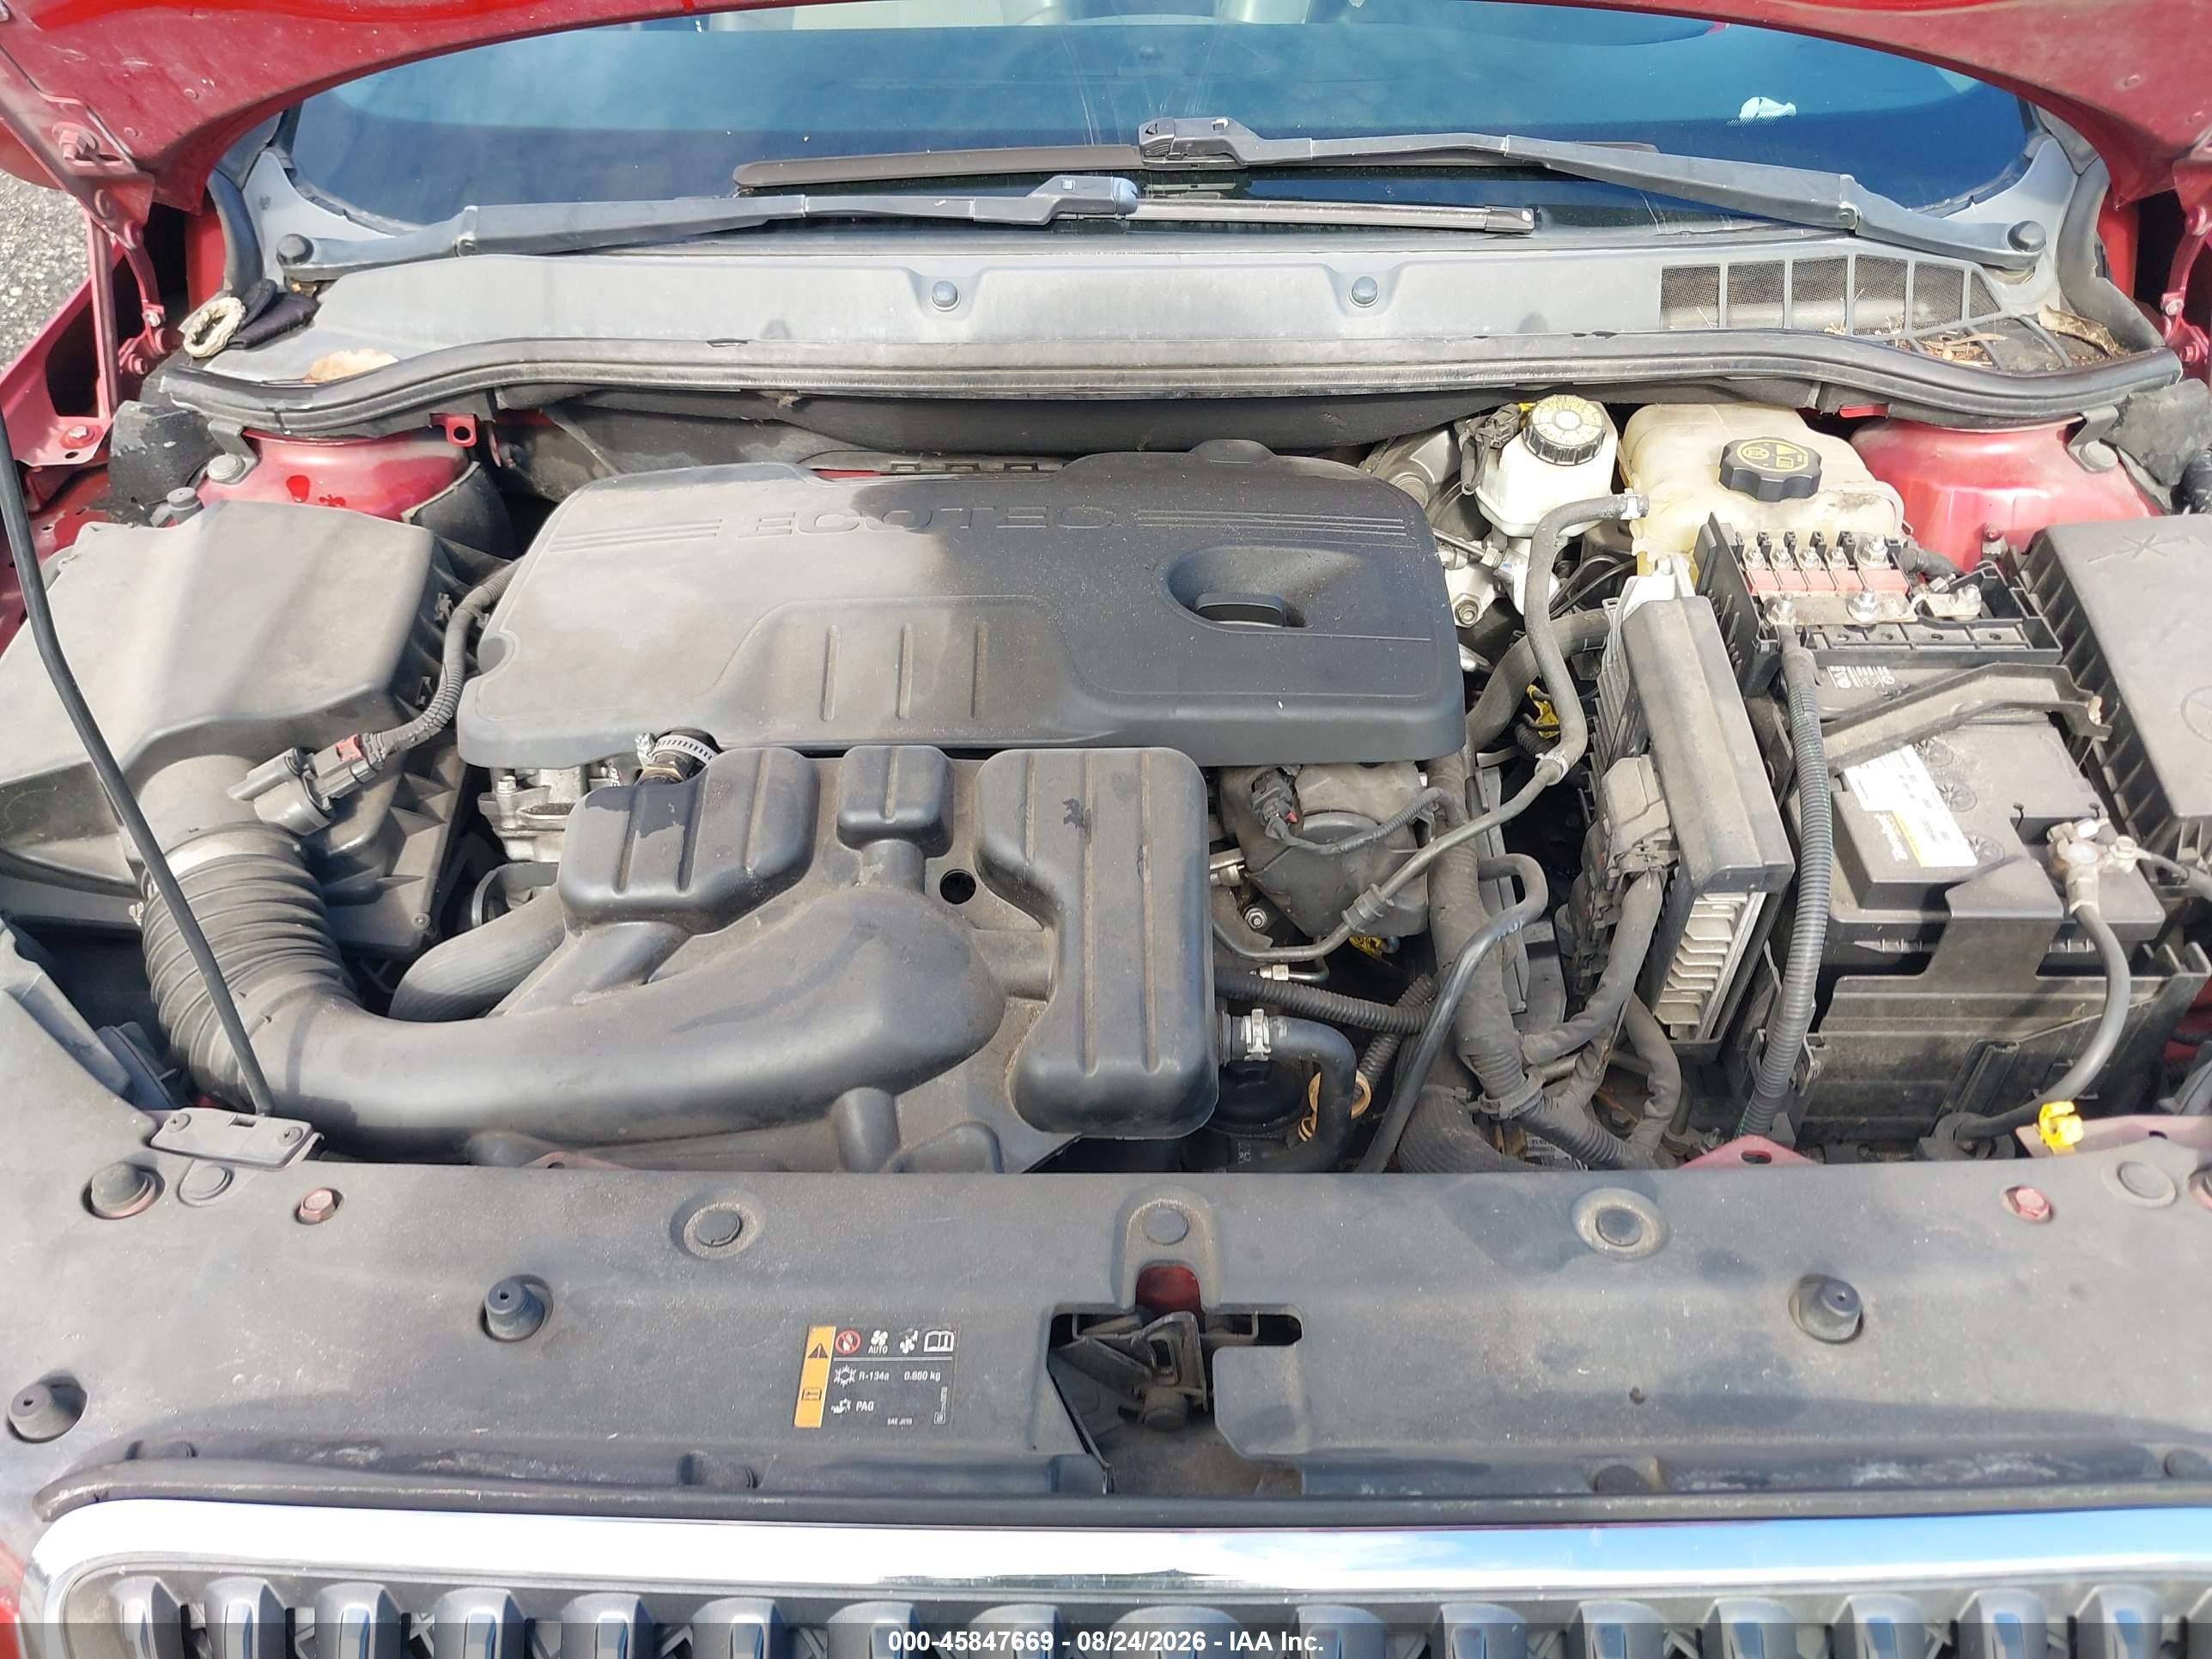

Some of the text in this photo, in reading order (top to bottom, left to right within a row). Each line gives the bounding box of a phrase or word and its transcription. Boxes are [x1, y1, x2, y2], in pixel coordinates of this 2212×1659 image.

[738, 505, 1118, 539] ECOTEC
[867, 1345, 889, 1354] AUTO
[929, 1370, 941, 1382] kg
